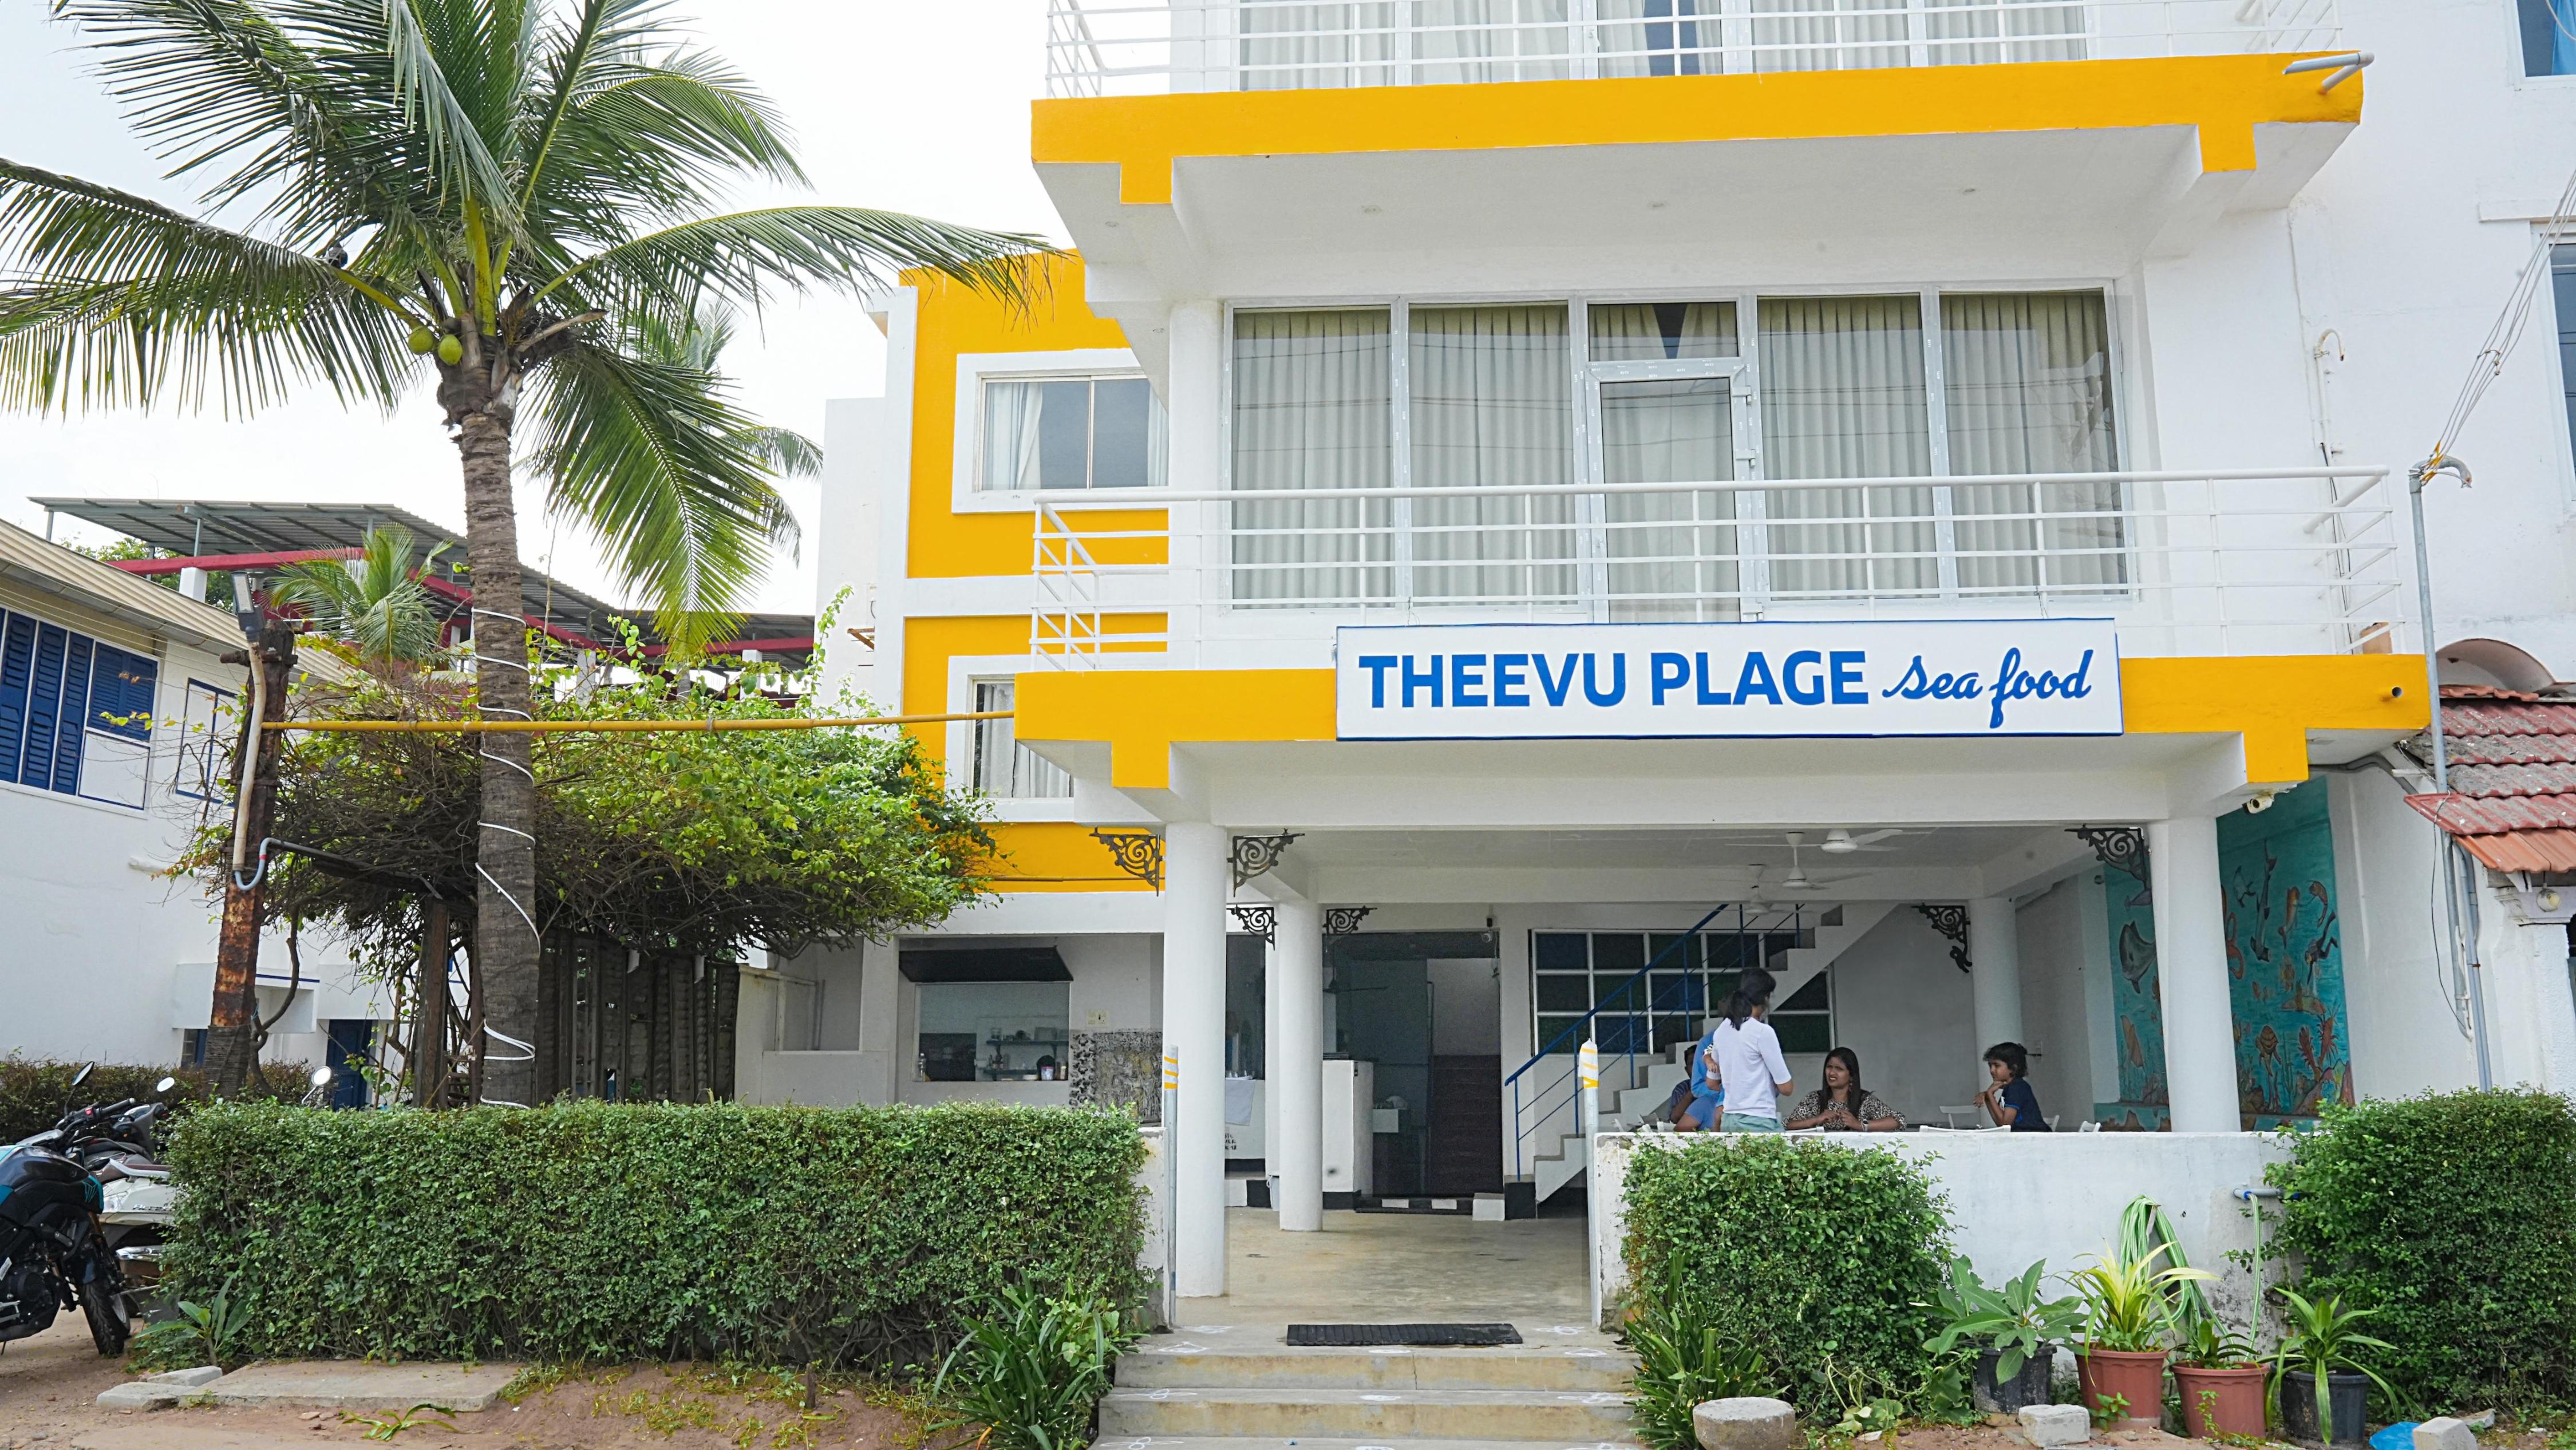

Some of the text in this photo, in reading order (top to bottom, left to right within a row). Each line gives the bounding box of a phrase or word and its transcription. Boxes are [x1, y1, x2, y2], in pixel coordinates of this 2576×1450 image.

[1358, 647, 2093, 729] THEEVU PLAGE sea food
